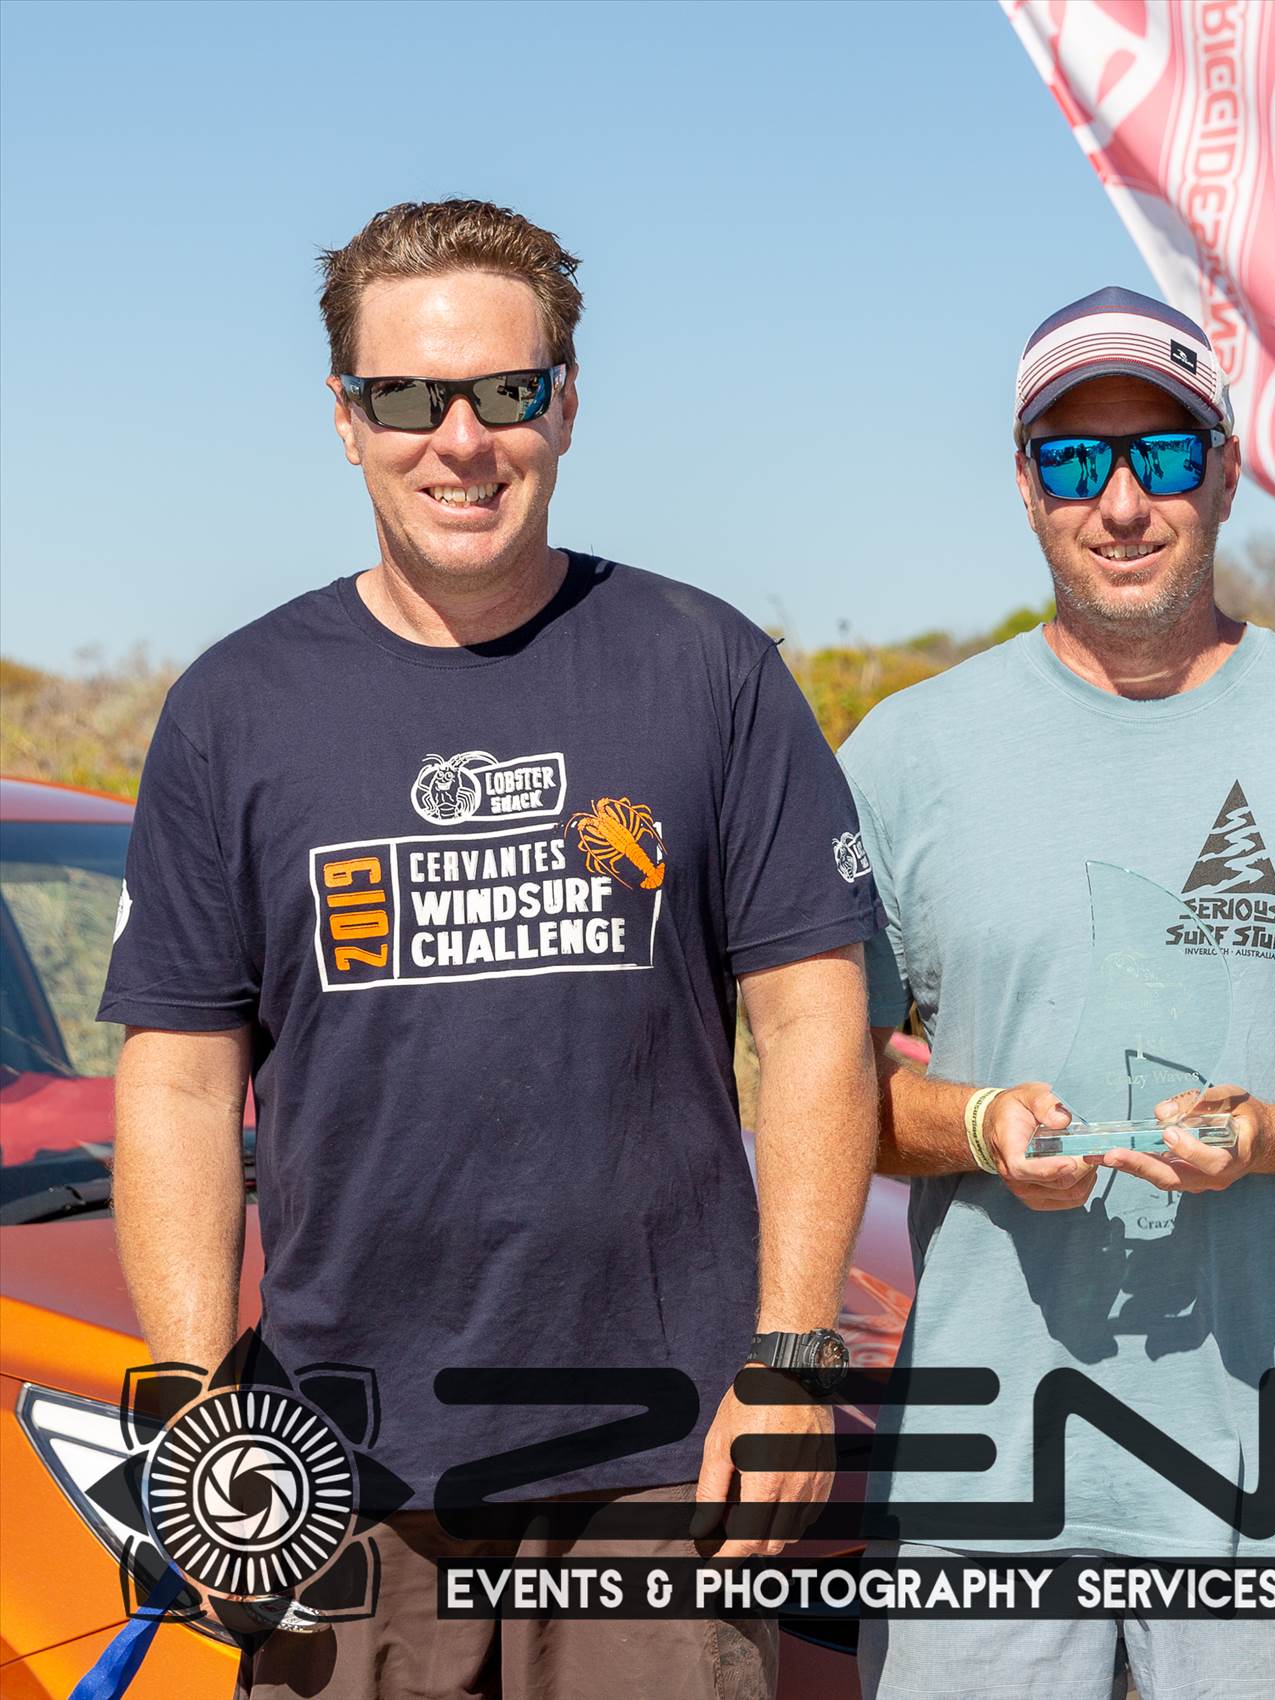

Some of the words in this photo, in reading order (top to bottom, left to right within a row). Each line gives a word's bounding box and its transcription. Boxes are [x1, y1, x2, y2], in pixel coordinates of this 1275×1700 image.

[485, 766, 556, 796] LOBSTER
[490, 789, 543, 814] SHACK
[409, 839, 566, 883] CERVANTES
[323, 856, 390, 971] 2019
[410, 875, 613, 926] WINDSURF
[410, 917, 626, 968] CHALLENGE
[1165, 923, 1230, 946] SURF
[1236, 949, 1275, 961] AUSTRALIA
